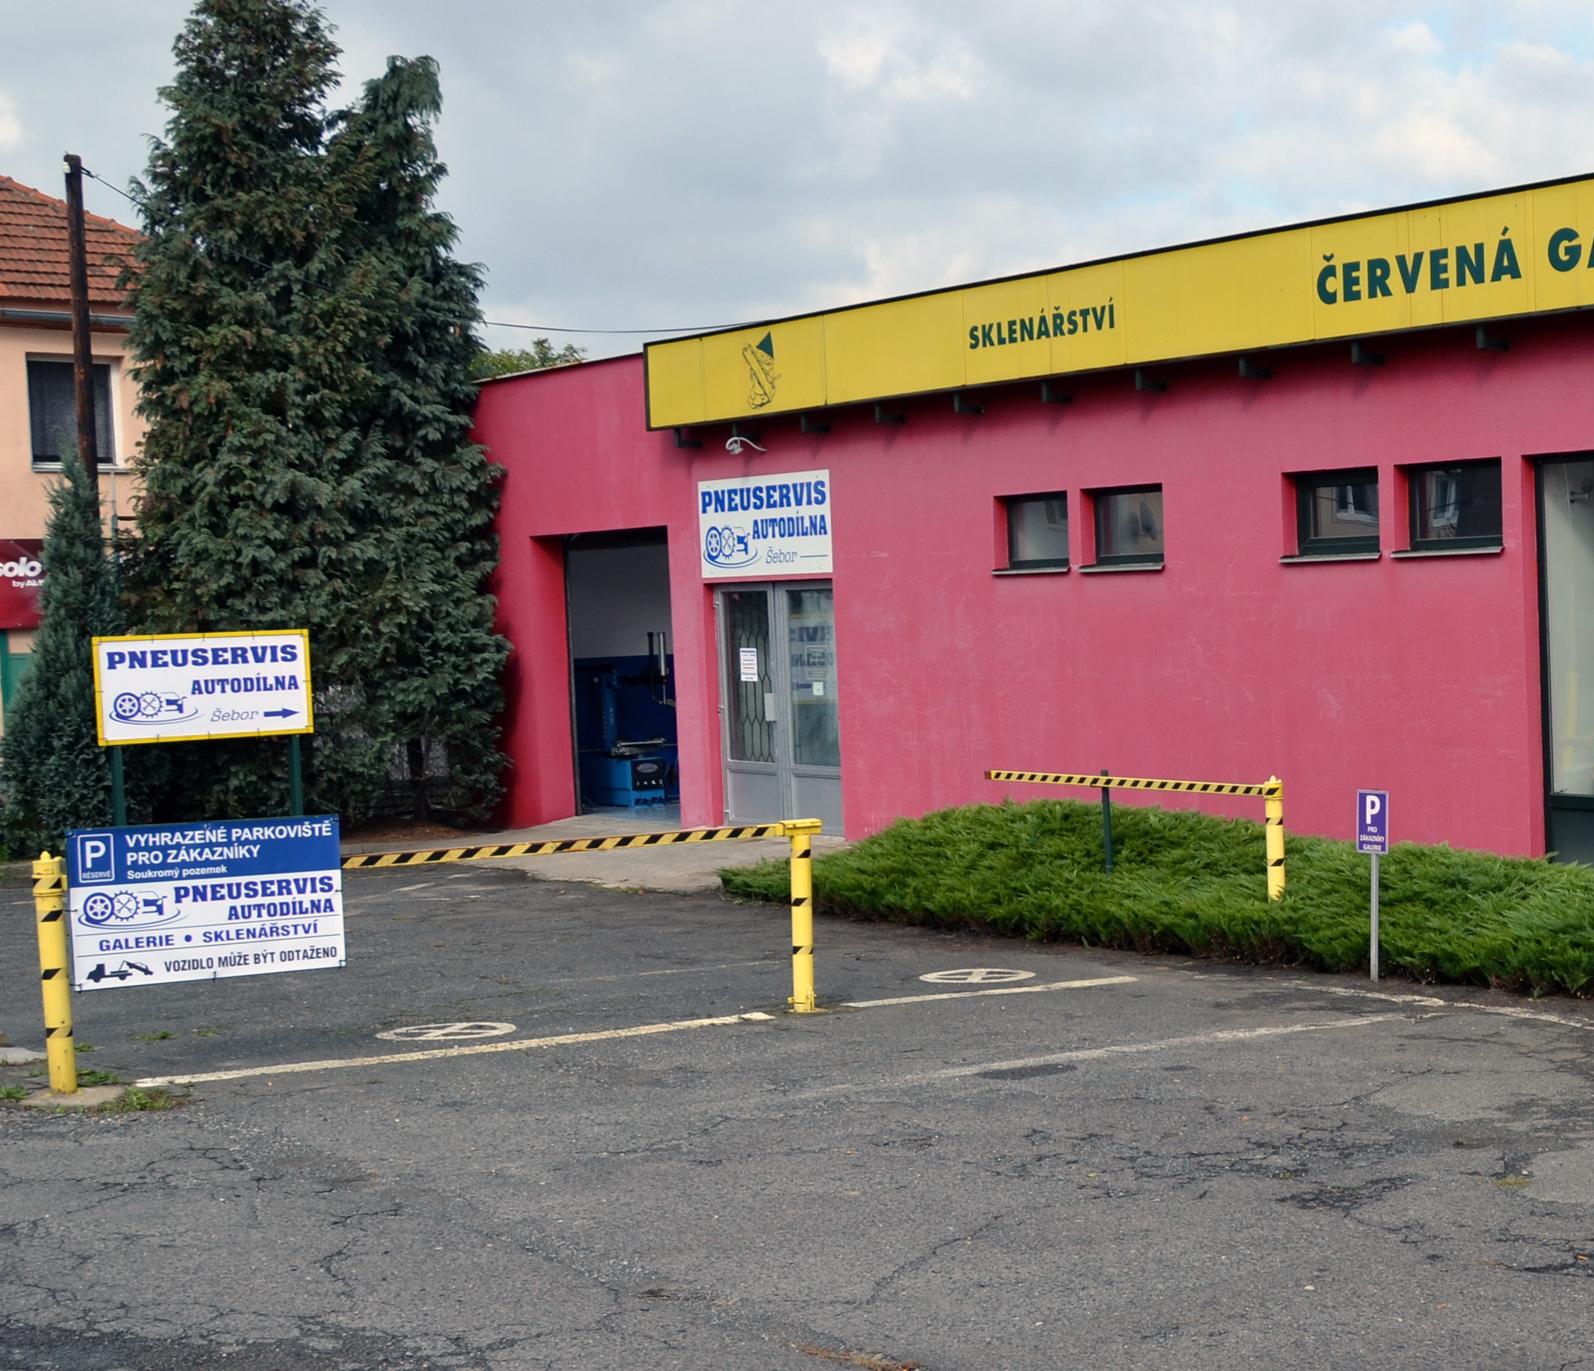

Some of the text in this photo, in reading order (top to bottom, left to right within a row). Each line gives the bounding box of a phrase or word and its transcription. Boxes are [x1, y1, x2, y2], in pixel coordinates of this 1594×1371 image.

[1316, 226, 1523, 306] ČERVENÁ
[968, 295, 1116, 351] SKLENÁŘSTVÍ
[701, 480, 827, 514] PNEUSERVIS
[752, 510, 828, 540] AUTODÍLNA
[765, 546, 798, 564] Šebor
[106, 644, 298, 670] PNEUSERVIS
[190, 673, 300, 696] AUTODÍLNA
[210, 707, 259, 723] Šebor
[1366, 795, 1380, 825] P
[125, 821, 332, 848] VYHRAZENÉ PARKOVIŠTĚ
[85, 840, 107, 869] P
[126, 844, 261, 866] PRO ZÁKAZNÍKY
[127, 864, 228, 880] Soukromý pozemek
[174, 875, 335, 904] PNEUSERVIS
[227, 897, 335, 921] AUTODÍLNA
[99, 920, 319, 951] GALERIE SKLENÁŘSTVÍ
[164, 946, 338, 973] VOZIDLO MŮŽE BÝT ODTAŽENO
